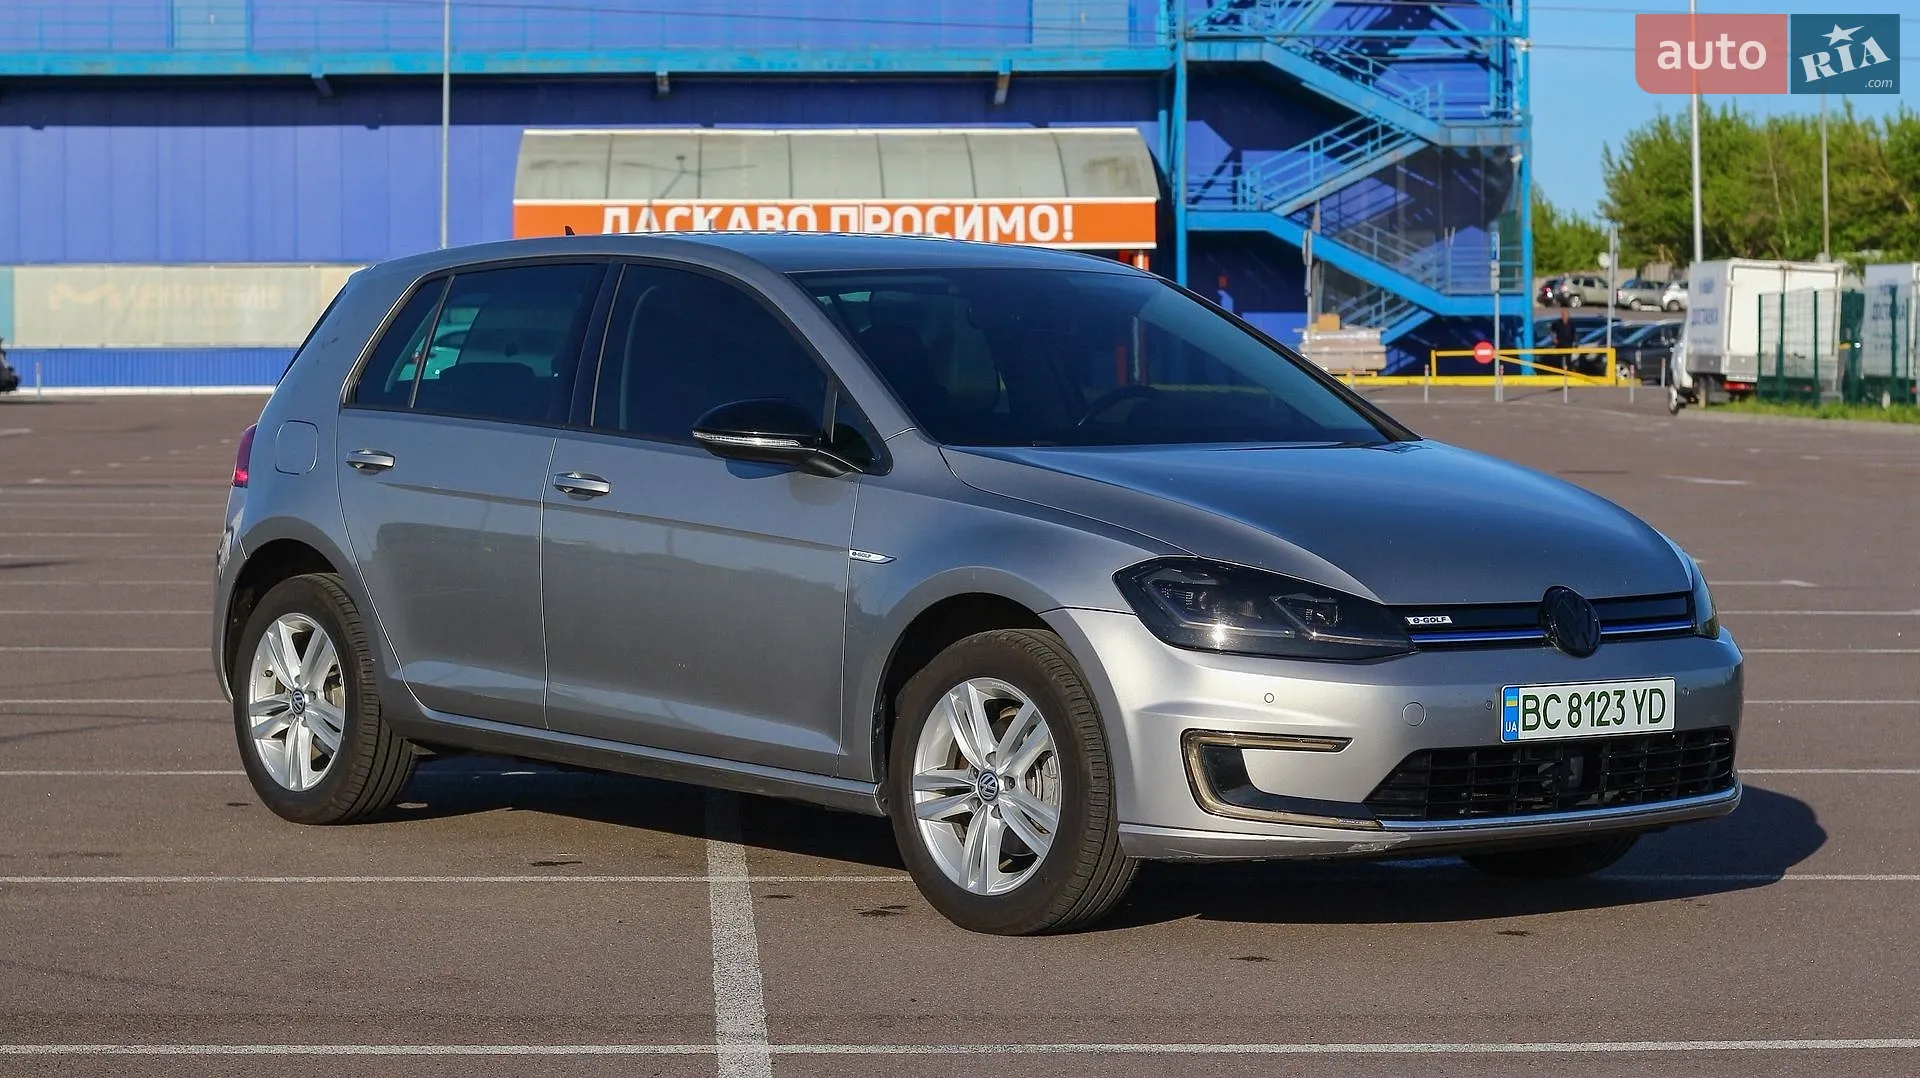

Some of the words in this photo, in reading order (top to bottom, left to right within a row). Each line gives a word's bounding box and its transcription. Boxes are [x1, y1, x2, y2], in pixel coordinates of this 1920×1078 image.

[602, 206, 817, 234] ЛАСКАВО
[829, 204, 1074, 242] ПРОСИМО!
[1505, 721, 1518, 733] UA
[1522, 693, 1562, 732] BC
[1567, 689, 1626, 729] 8123
[1632, 687, 1667, 725] YD
